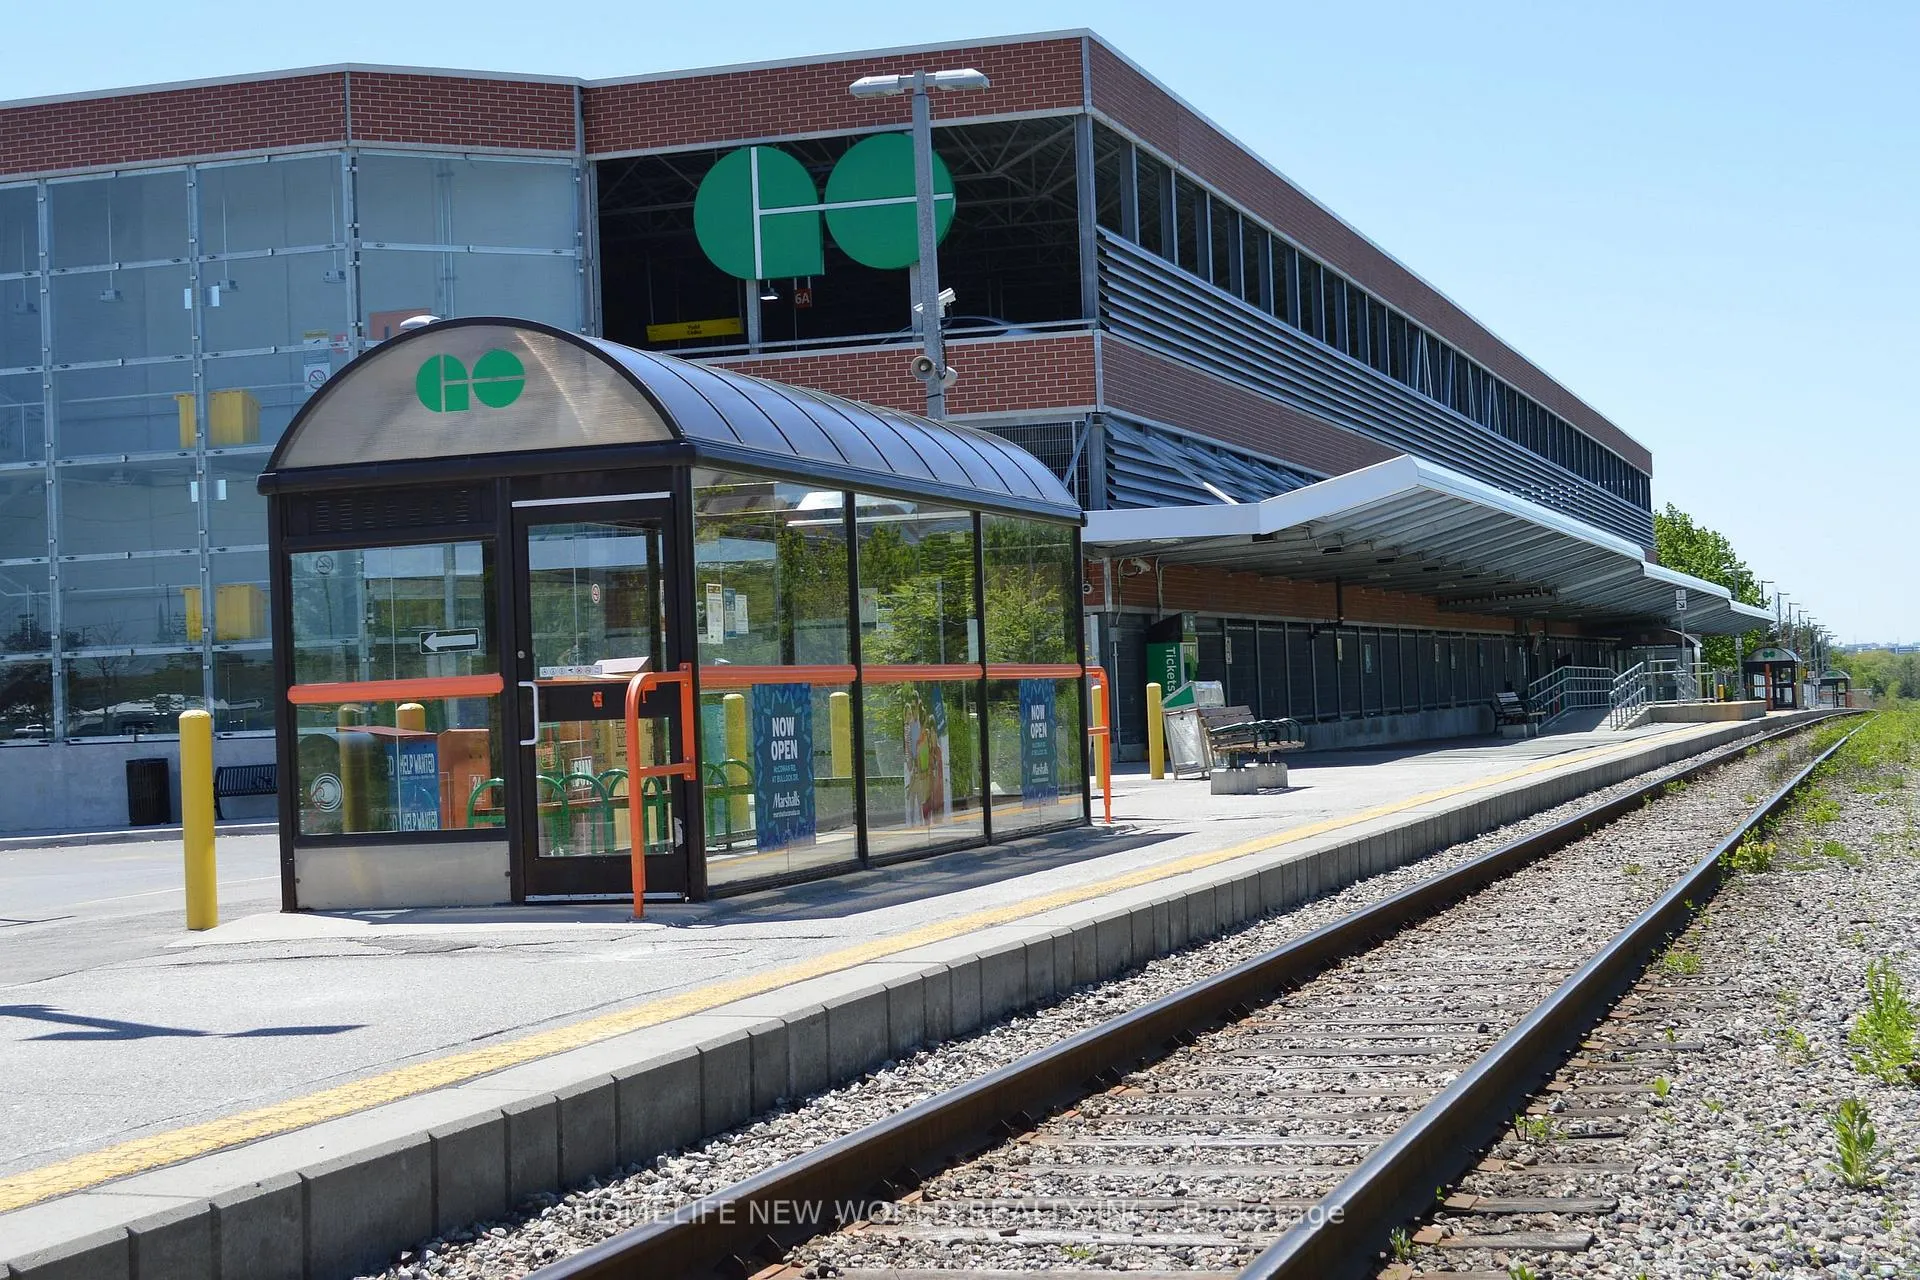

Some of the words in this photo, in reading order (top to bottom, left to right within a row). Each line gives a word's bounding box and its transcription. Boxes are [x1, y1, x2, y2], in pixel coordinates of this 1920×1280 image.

[795, 294, 810, 305] 6A
[1031, 704, 1046, 720] NOW
[772, 717, 795, 737] NOW
[1030, 722, 1048, 739] OPEN
[771, 740, 798, 760] OPEN
[400, 754, 414, 775] HELP
[413, 753, 435, 774] WANTED
[773, 791, 801, 809] Marshalls
